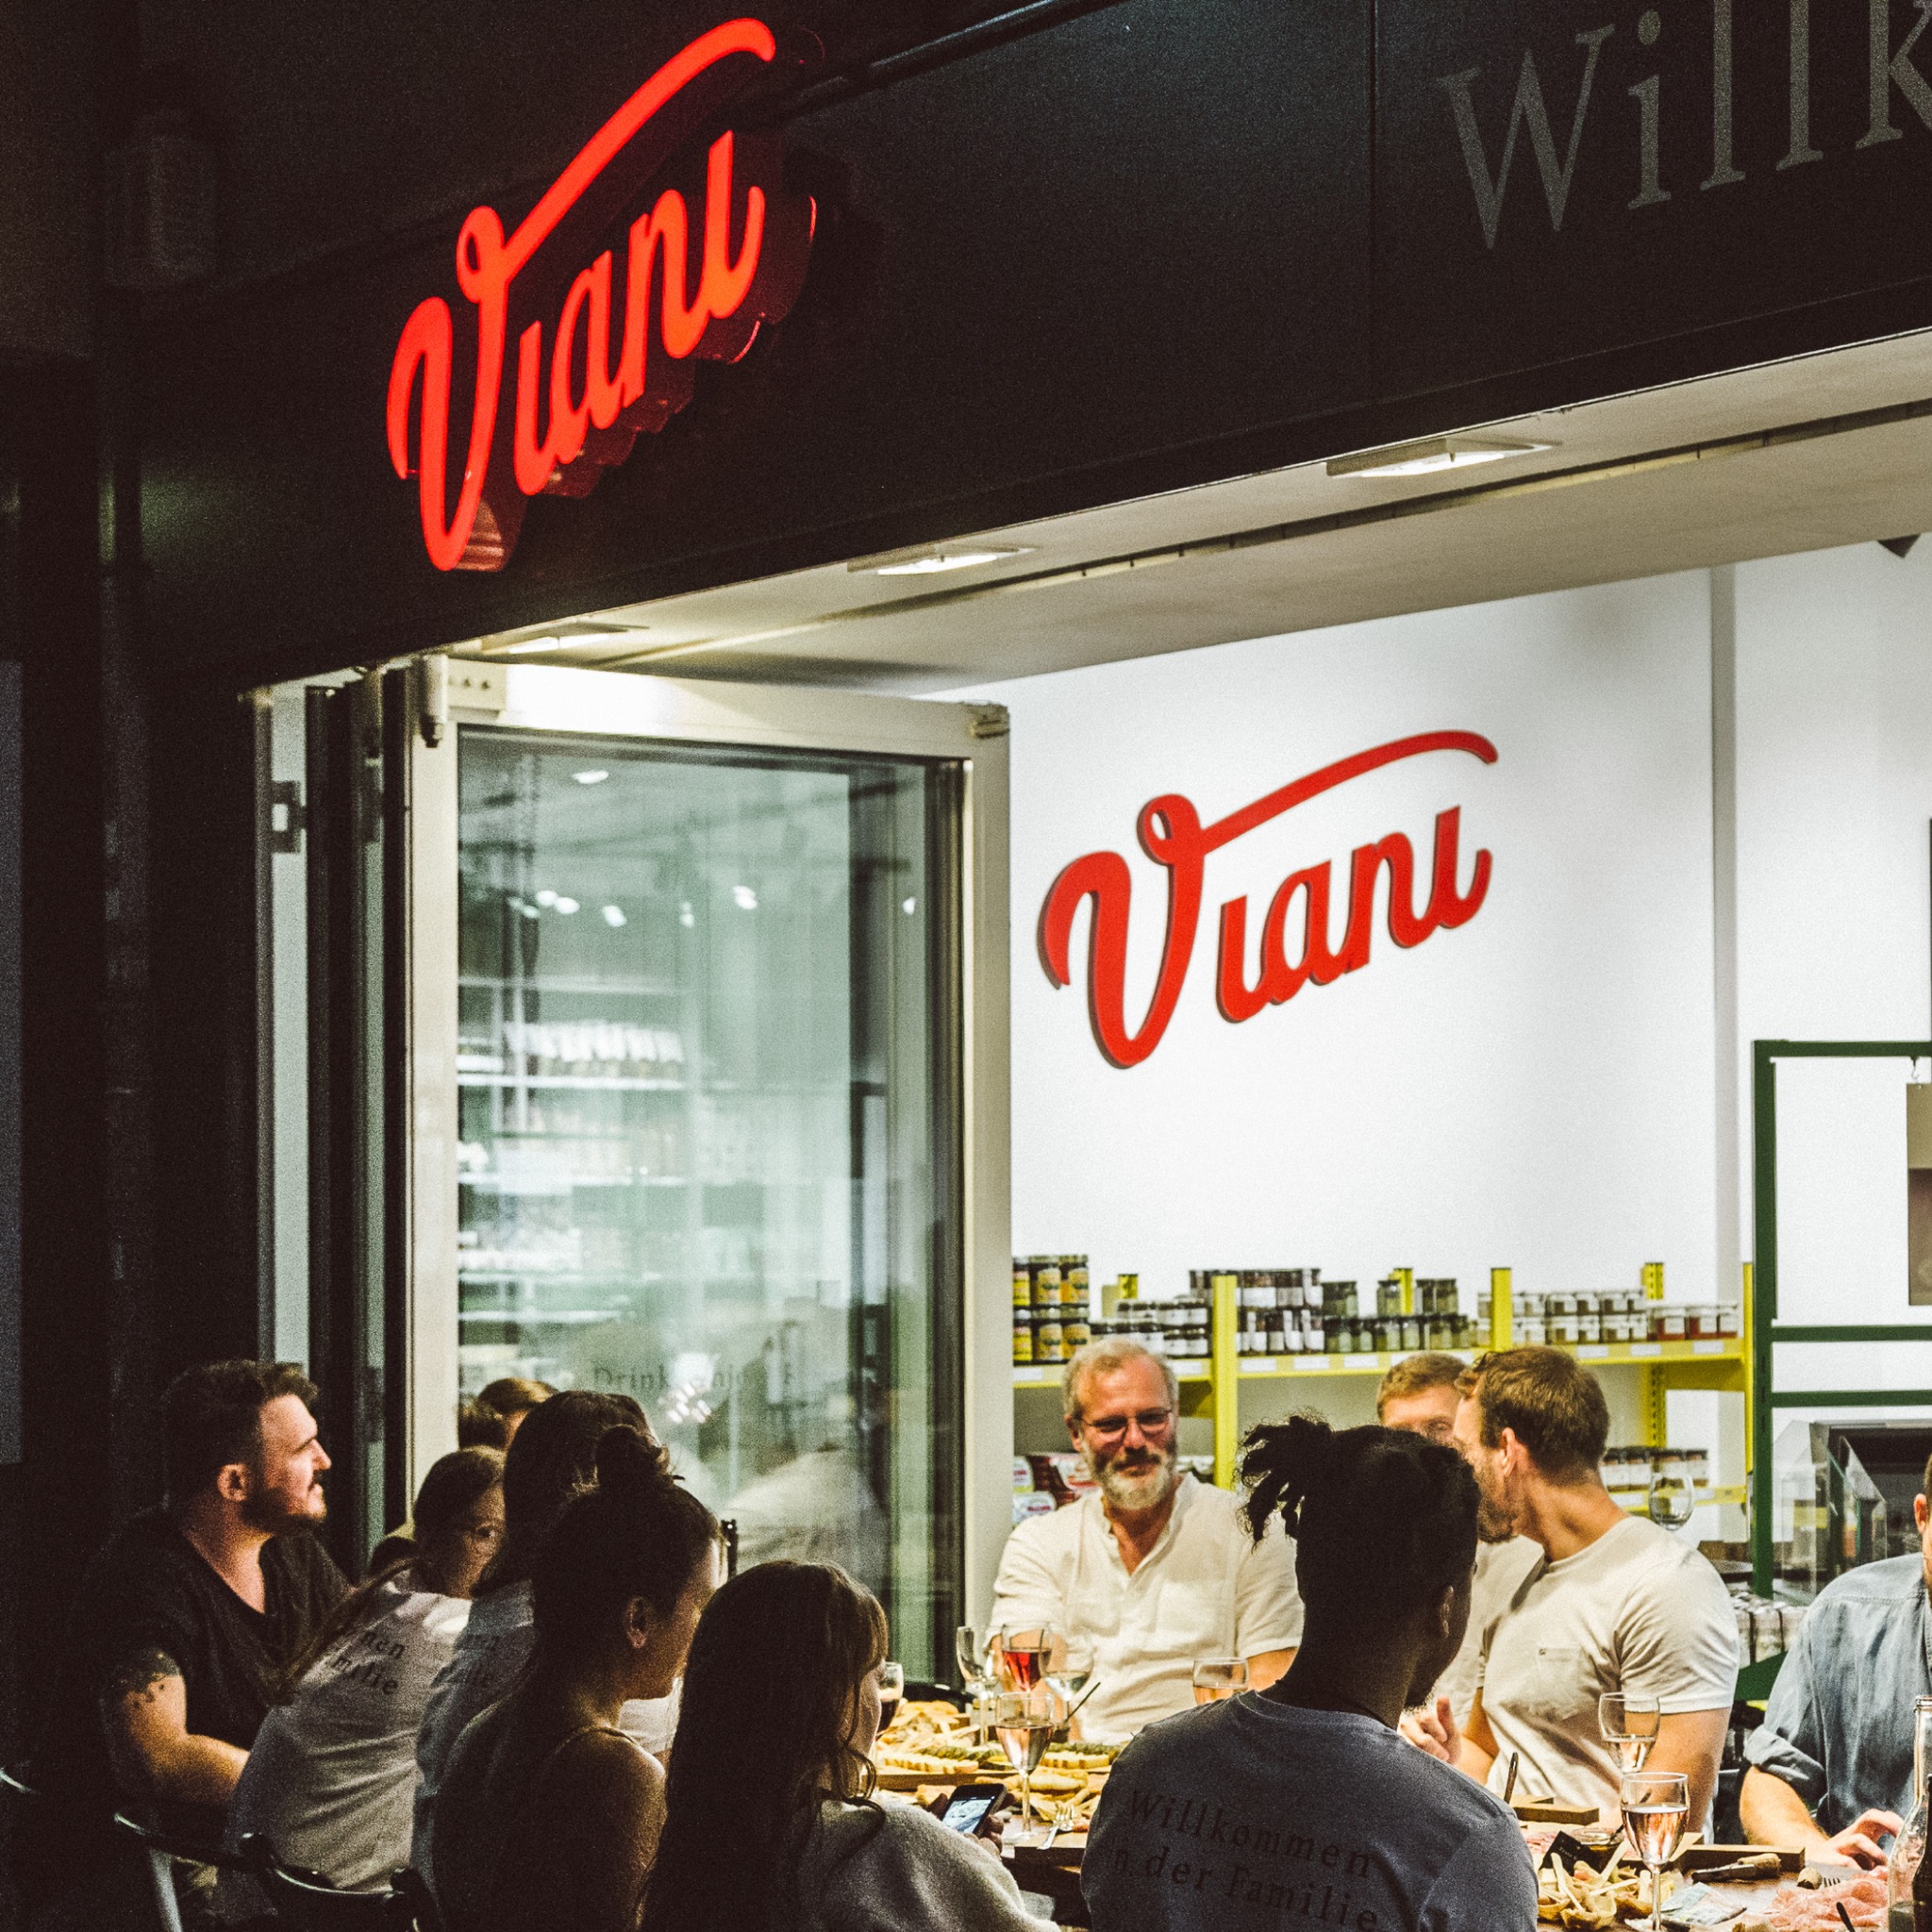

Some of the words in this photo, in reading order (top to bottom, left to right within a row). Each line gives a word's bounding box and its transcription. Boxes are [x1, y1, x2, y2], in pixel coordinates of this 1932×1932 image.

[386, 17, 776, 571] Viani
[1038, 729, 1498, 1069] Viani
[1132, 1791, 1372, 1878] Willkommen
[1145, 1846, 1213, 1890] der
[1226, 1865, 1378, 1932] Familie
